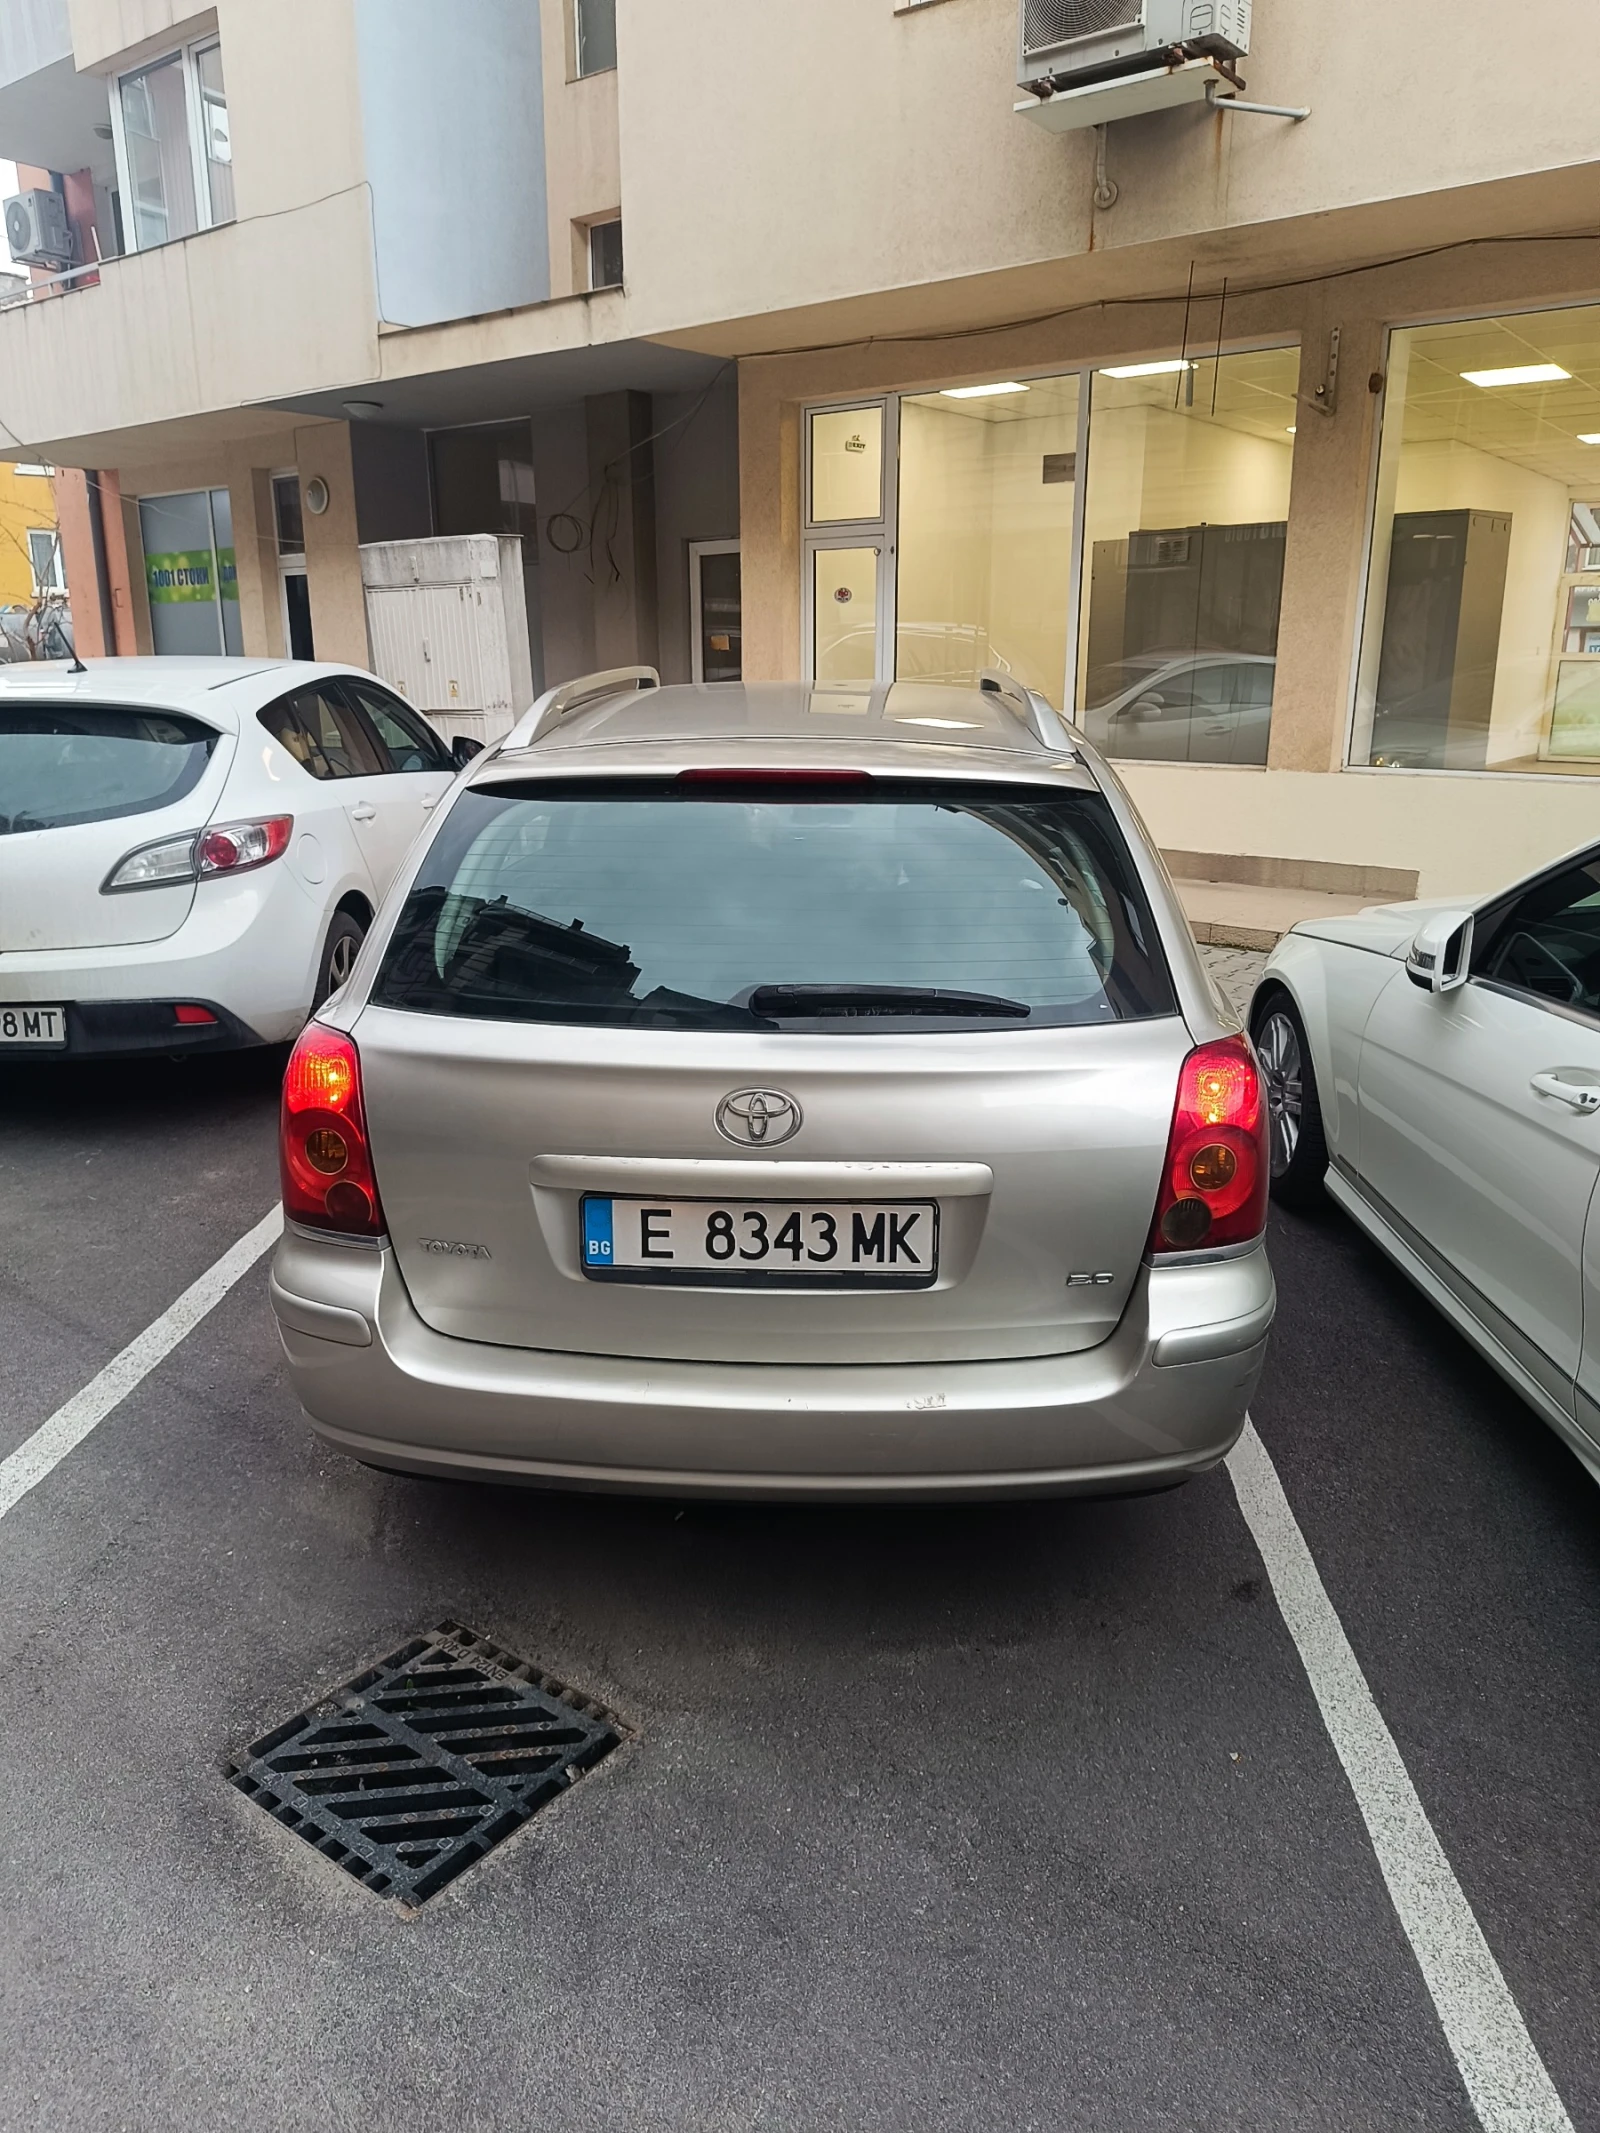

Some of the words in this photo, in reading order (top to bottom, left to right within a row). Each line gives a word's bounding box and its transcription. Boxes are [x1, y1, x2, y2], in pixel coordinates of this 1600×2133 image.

[153, 569, 176, 587] 1001
[177, 566, 209, 586] СТОКИ
[0, 1011, 18, 1037] 8
[640, 1208, 674, 1259] E
[418, 1238, 492, 1260] TOYOTA
[589, 1240, 611, 1255] BG
[1066, 1272, 1114, 1287] 2.0
[436, 1636, 459, 1652] 400
[457, 1649, 471, 1660] D
[469, 1655, 510, 1681] EN124
